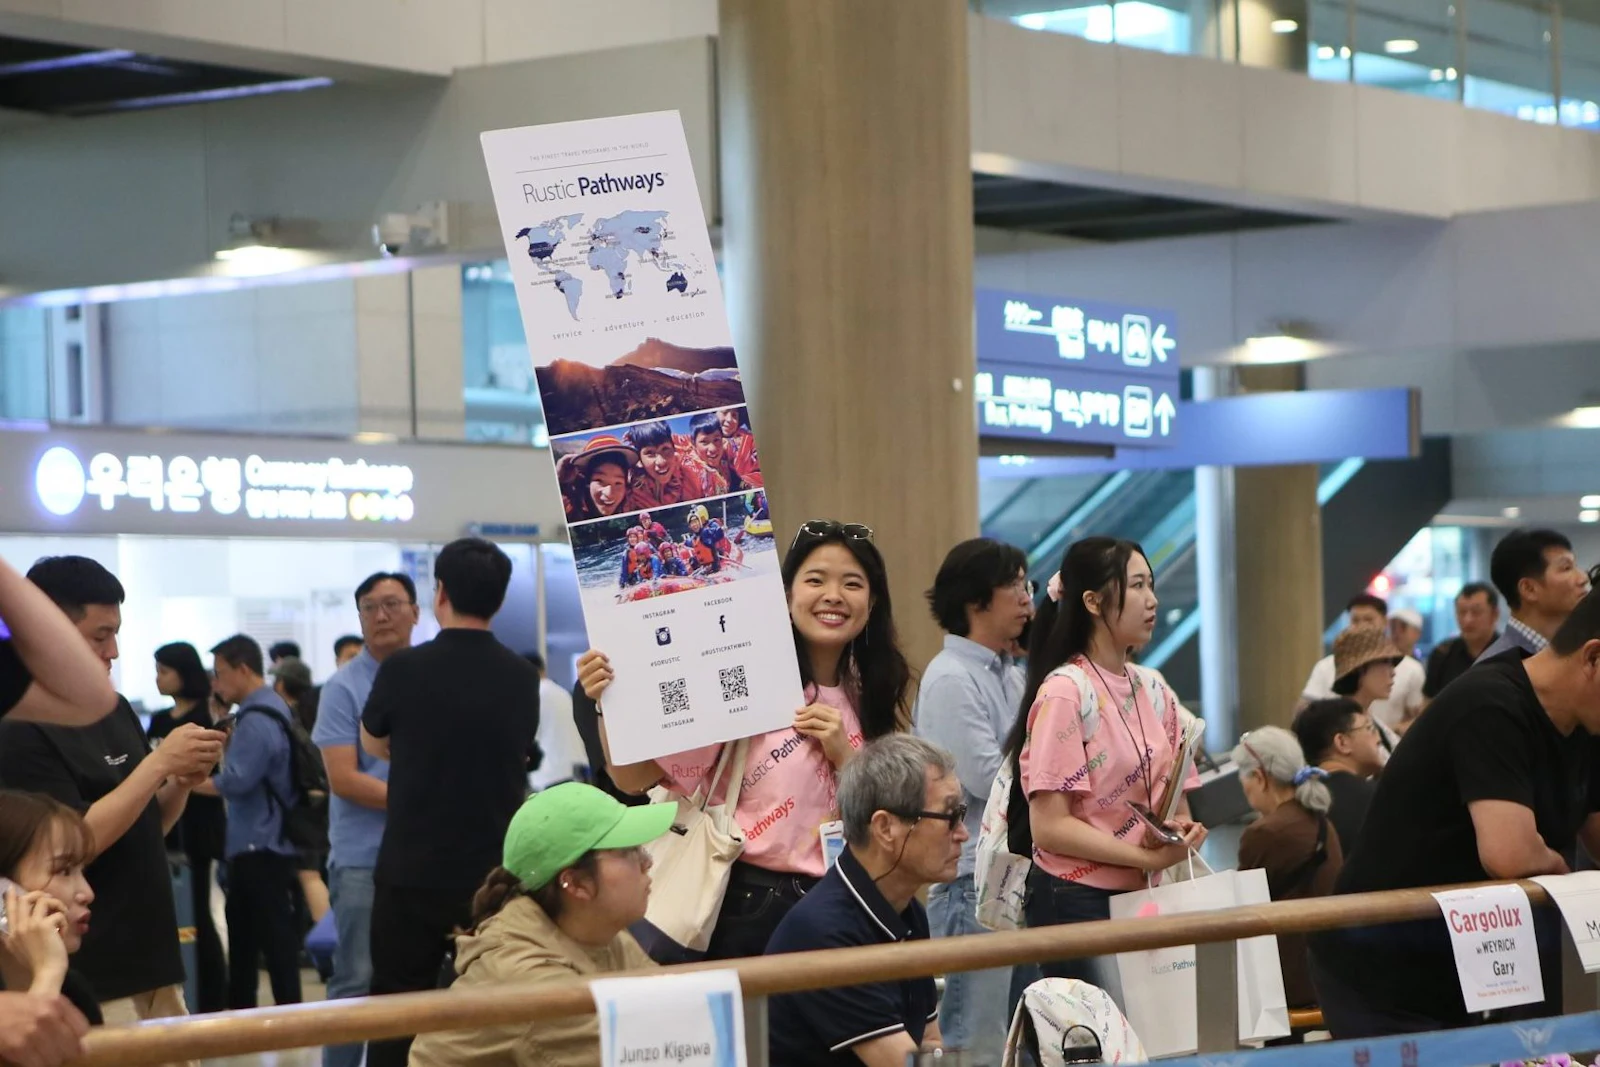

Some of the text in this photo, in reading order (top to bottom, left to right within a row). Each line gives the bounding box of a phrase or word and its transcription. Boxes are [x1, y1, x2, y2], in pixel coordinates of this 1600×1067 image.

[522, 171, 665, 204] Rustic Pathways
[552, 310, 705, 341] service adventure education
[703, 597, 733, 607] FACEBOOK
[642, 608, 676, 620] INSTAGRAM
[661, 717, 695, 730] INSTAGRAM
[742, 758, 776, 792] Rustic
[1449, 904, 1522, 934] Cargolux
[1482, 938, 1516, 954] WEYRICH
[1492, 960, 1515, 977] Gary
[620, 1040, 711, 1064] Junzo Kigawa
